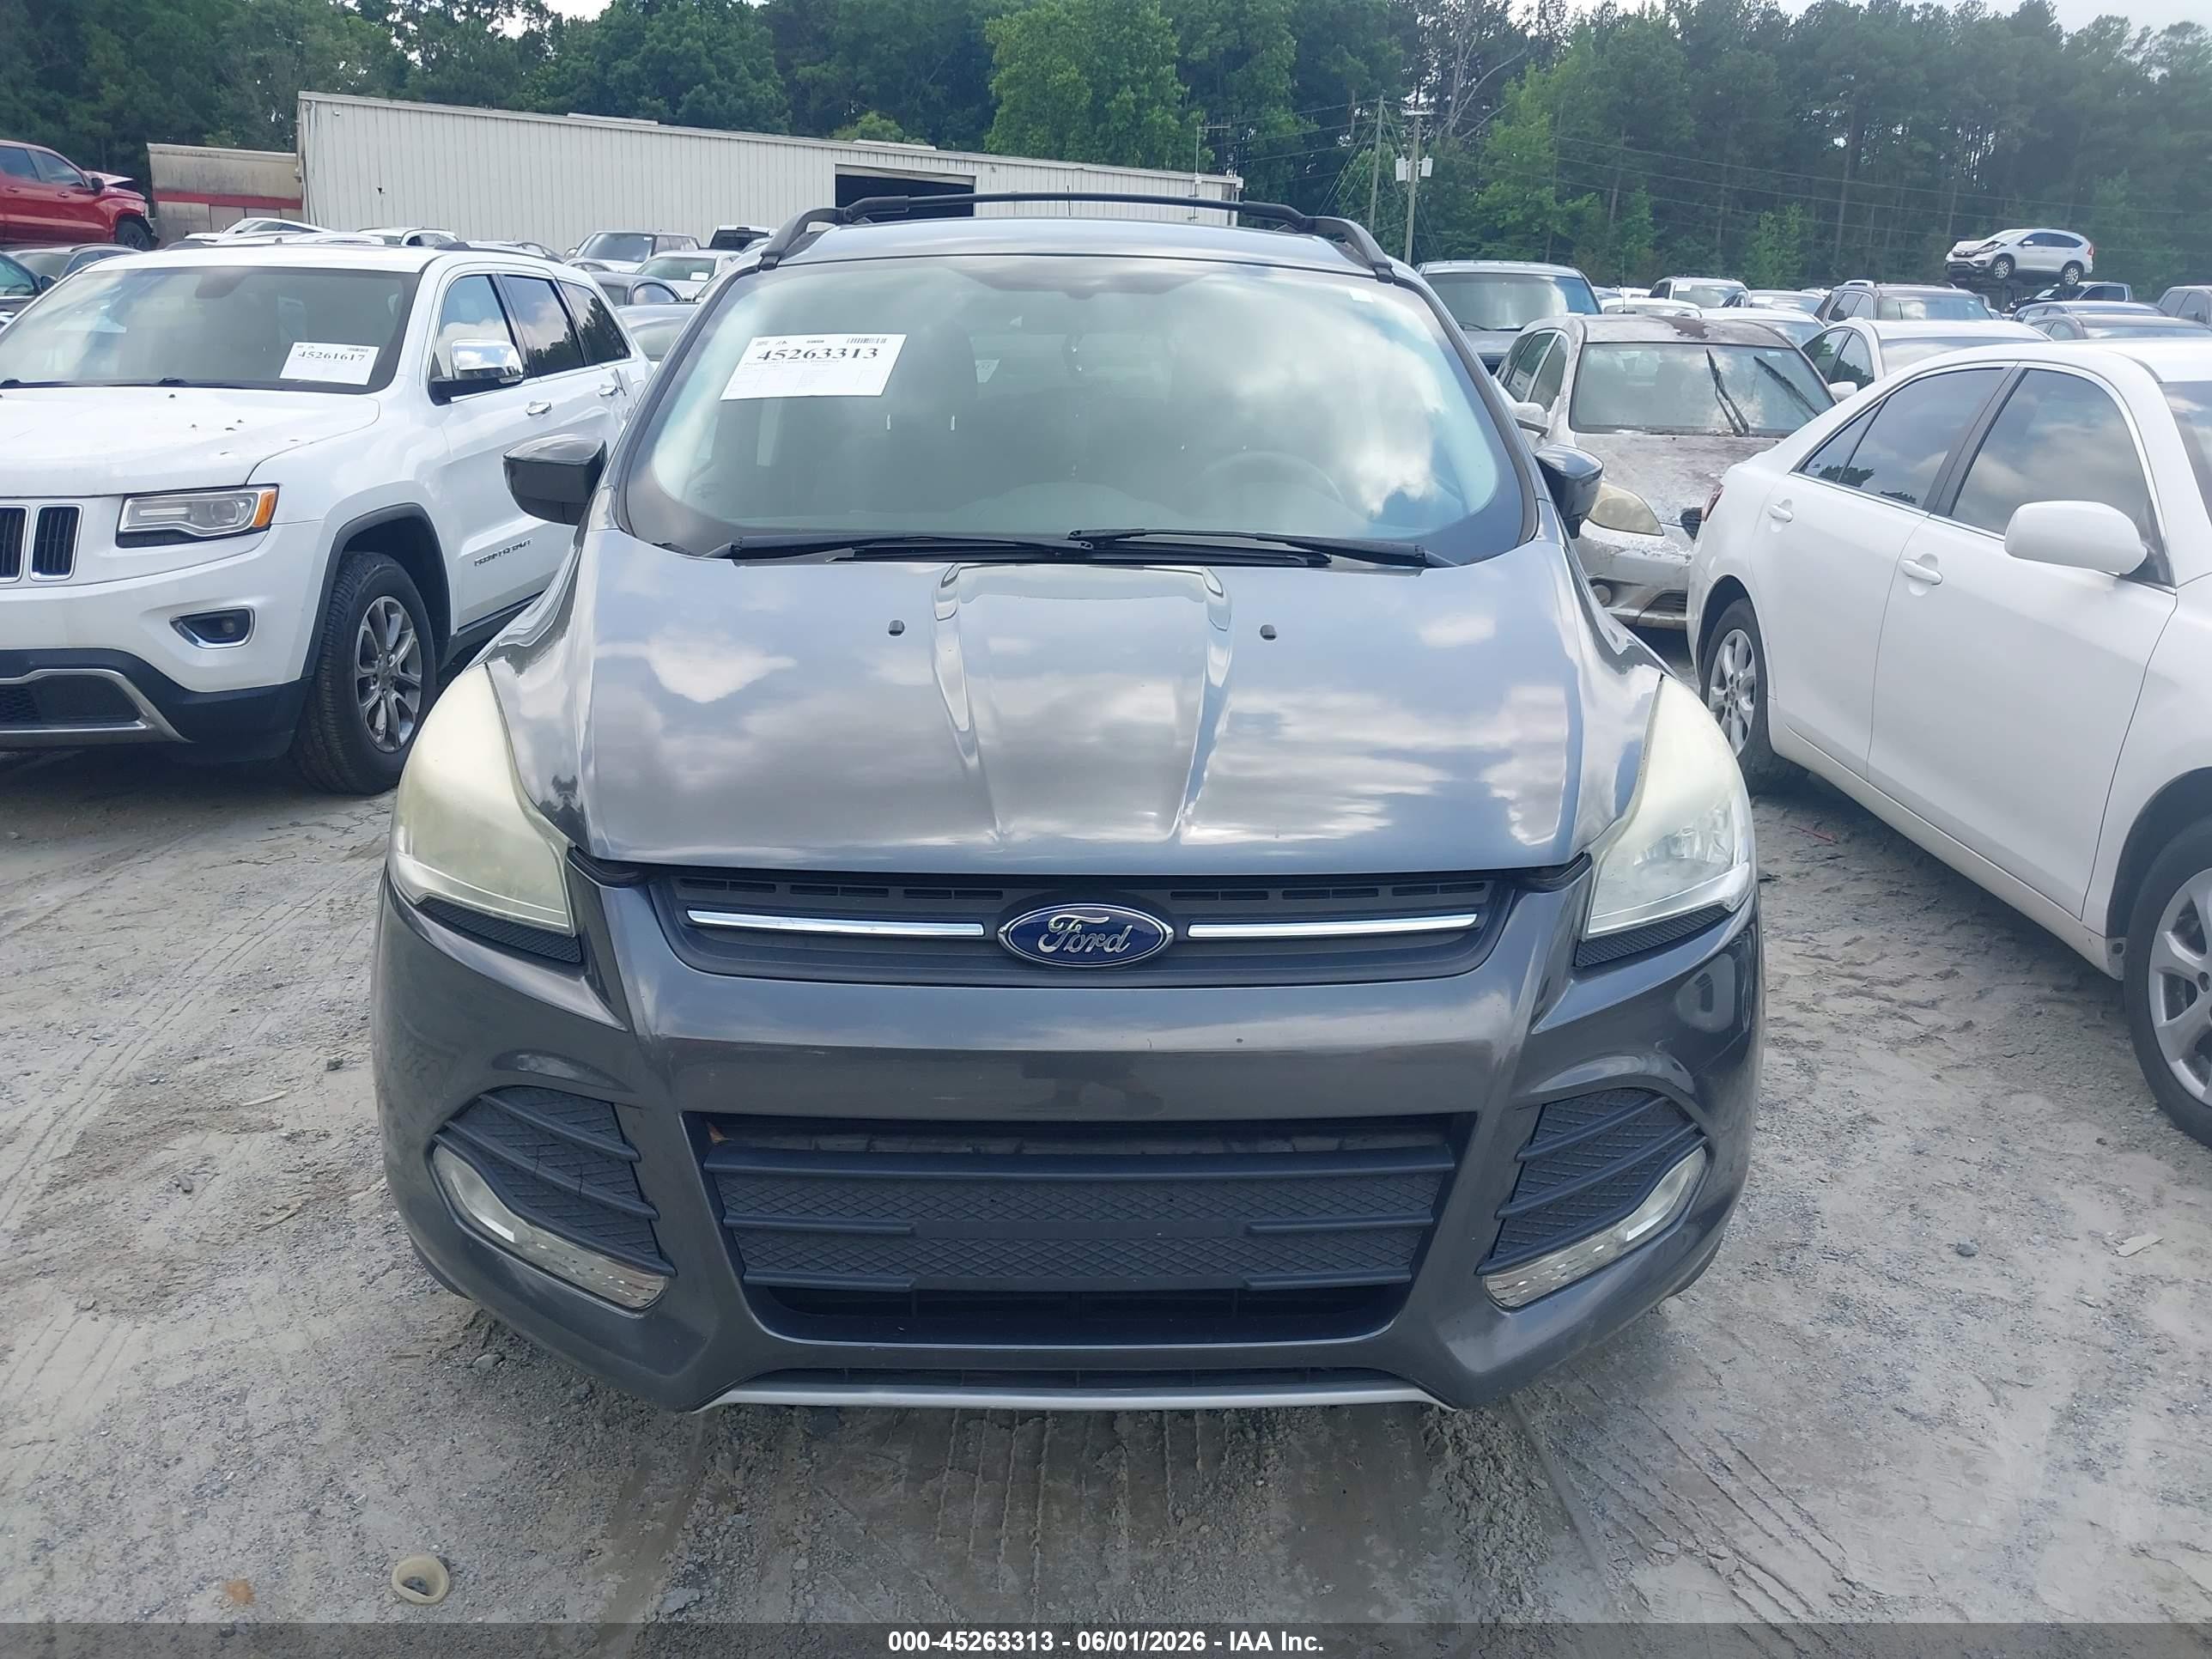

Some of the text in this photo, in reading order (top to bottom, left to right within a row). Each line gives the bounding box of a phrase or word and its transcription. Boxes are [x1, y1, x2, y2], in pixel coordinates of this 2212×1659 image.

[298, 350, 365, 362] 45261617
[757, 348, 878, 360] 45263313
[1037, 914, 1133, 953] Ford
